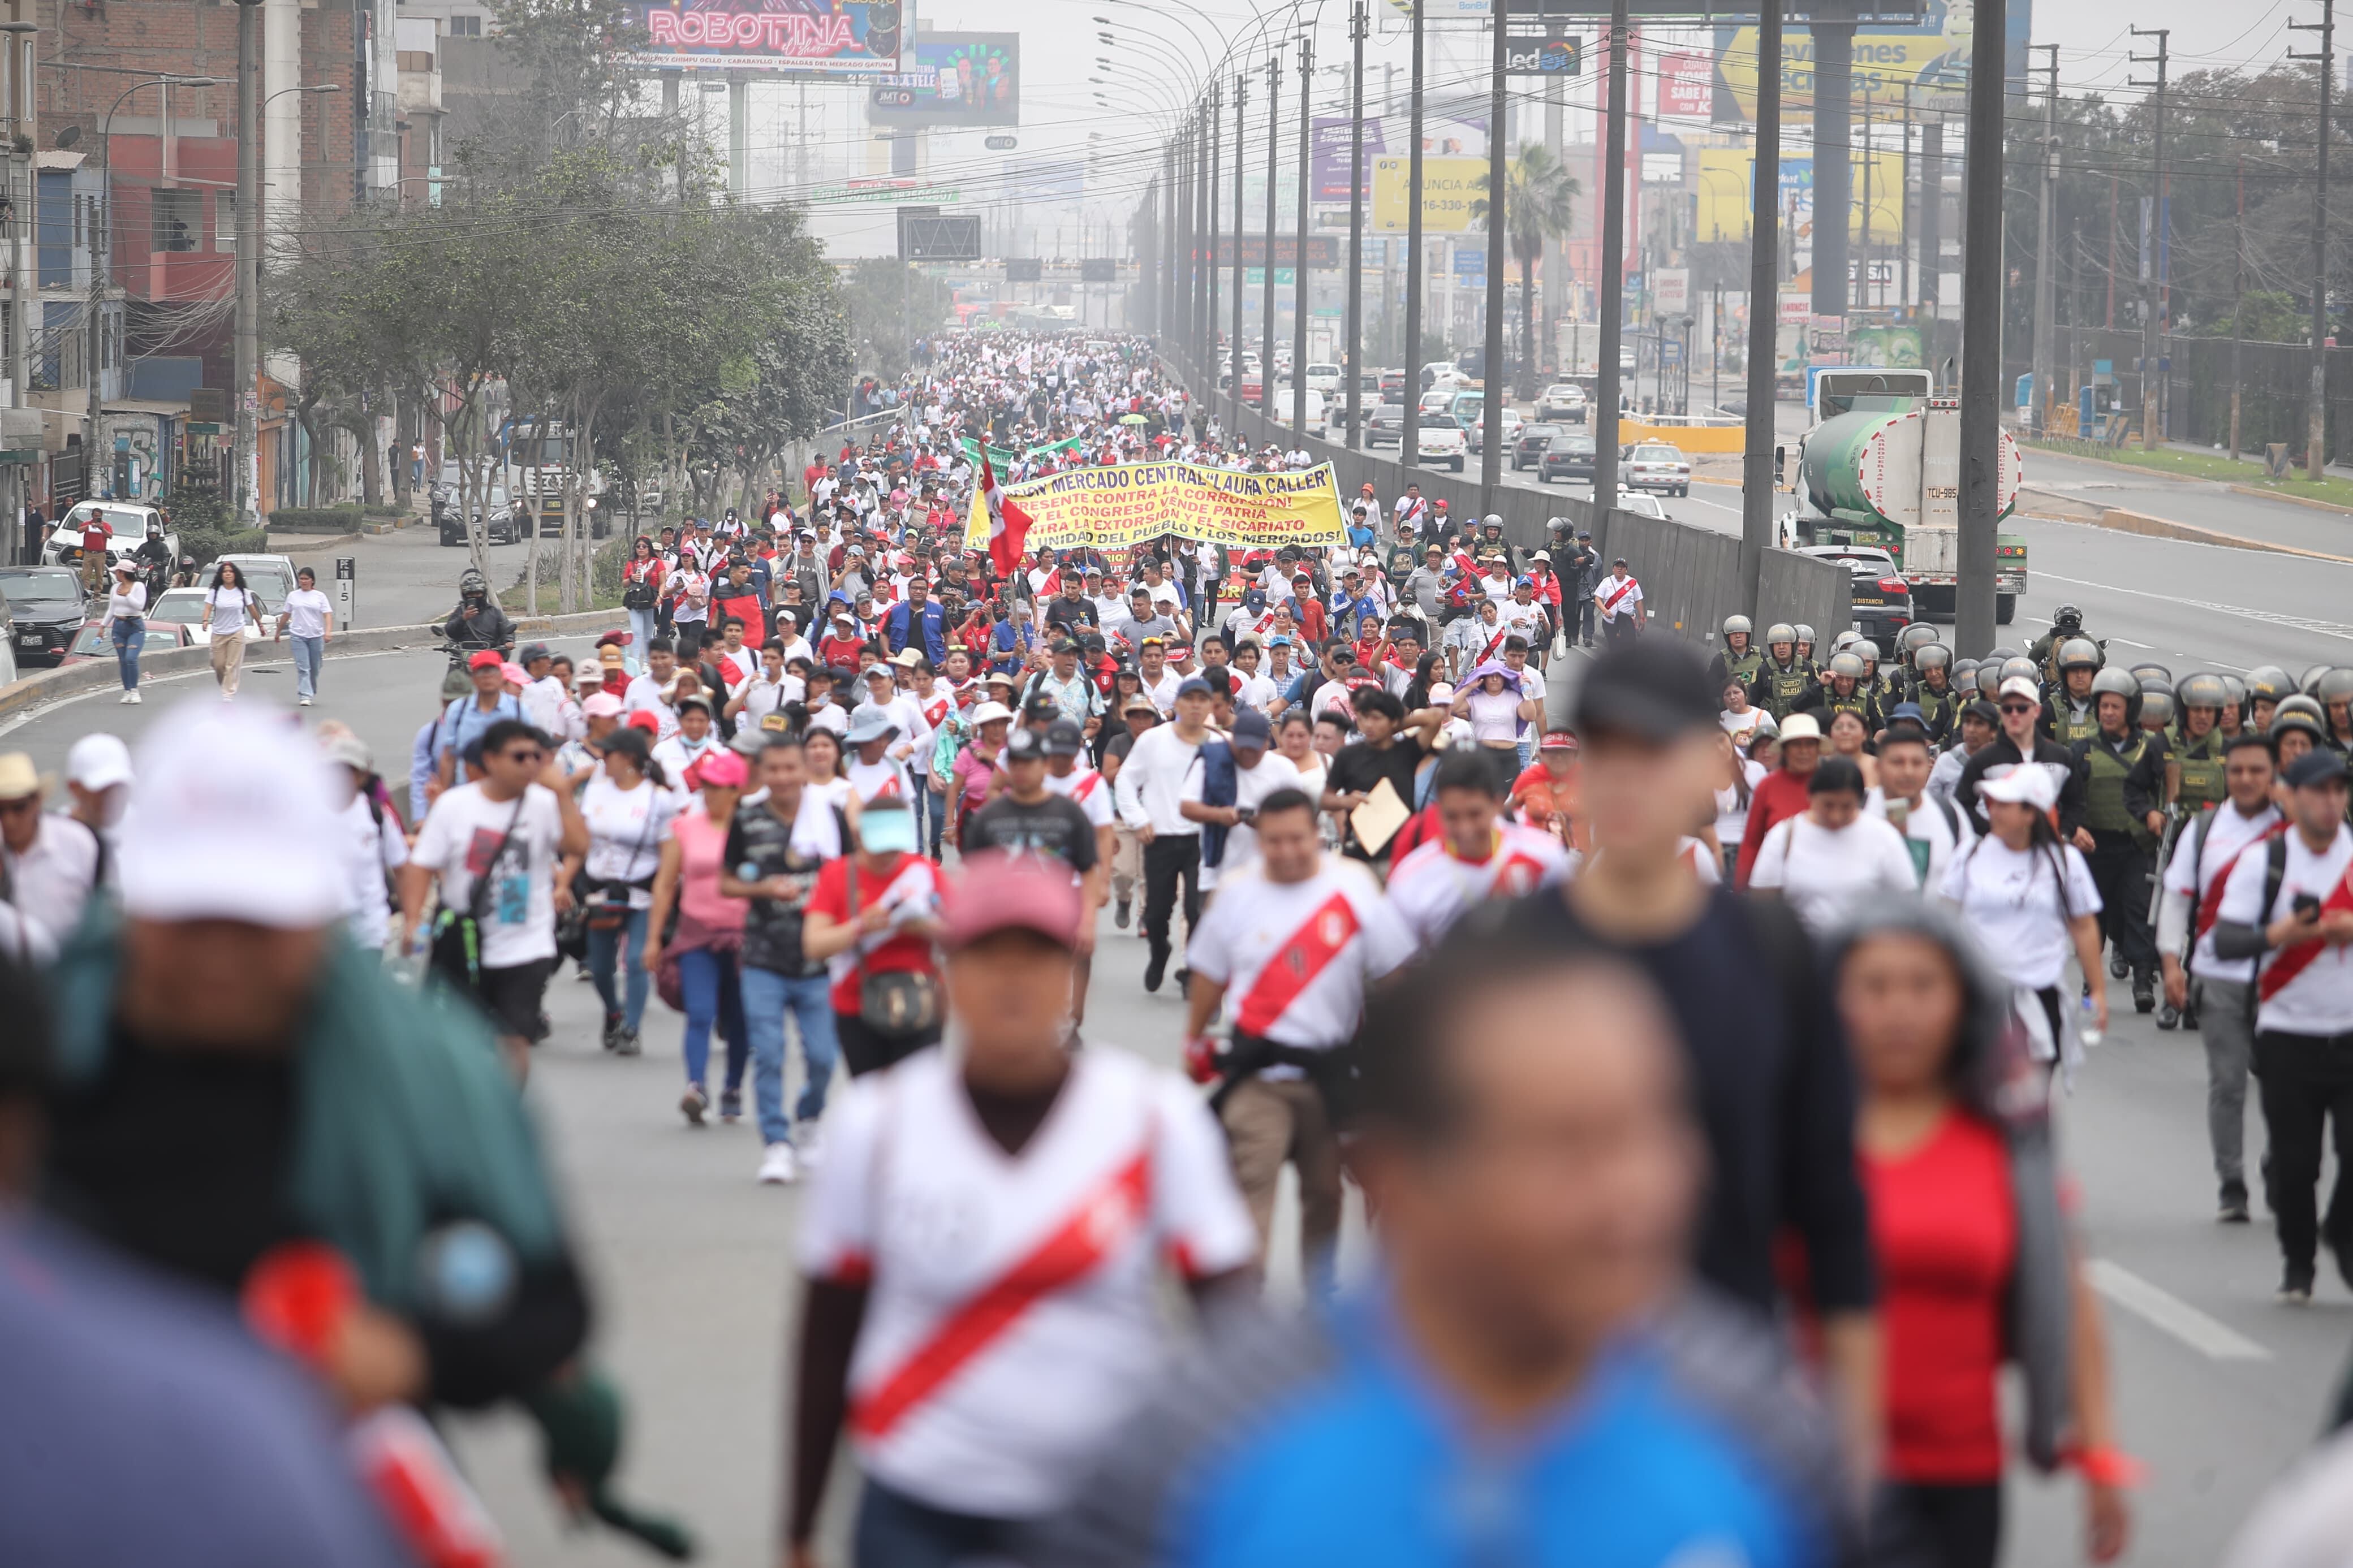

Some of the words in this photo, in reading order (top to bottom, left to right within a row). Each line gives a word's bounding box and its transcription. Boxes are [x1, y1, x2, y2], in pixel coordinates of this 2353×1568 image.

[1459, 1, 1488, 10] BanBif
[649, 10, 863, 51] ROBOTINA
[1506, 47, 1566, 71] ledex
[1670, 87, 1700, 100] SABE
[1402, 179, 1463, 191] AUNCIA
[1051, 469, 1129, 494] MERCADO
[1135, 465, 1206, 487] CENTRAL
[1093, 488, 1158, 505] CONTRA
[1163, 485, 1179, 495] LA
[1928, 488, 1956, 498] TCU-985
[1046, 508, 1065, 521] EL
[1069, 501, 1155, 518] CONGRESO
[1160, 496, 1208, 513] VENDE
[1213, 504, 1267, 519] PATRIA
[1028, 521, 1069, 534] NTRA
[1074, 519, 1089, 529] LA
[1093, 506, 1180, 530] EXTORSIÓN
[1184, 513, 1193, 522] Y
[1197, 516, 1216, 527] EL
[1219, 519, 1305, 533] SICARIATO
[1037, 532, 1094, 546] UNIDAD
[1097, 533, 1128, 545] DEL
[1132, 520, 1189, 539] PUEBLO
[1193, 526, 1203, 536] Y
[1207, 529, 1238, 542] LOS
[1242, 530, 1341, 544] MERCADOS!
[340, 560, 350, 569] PE
